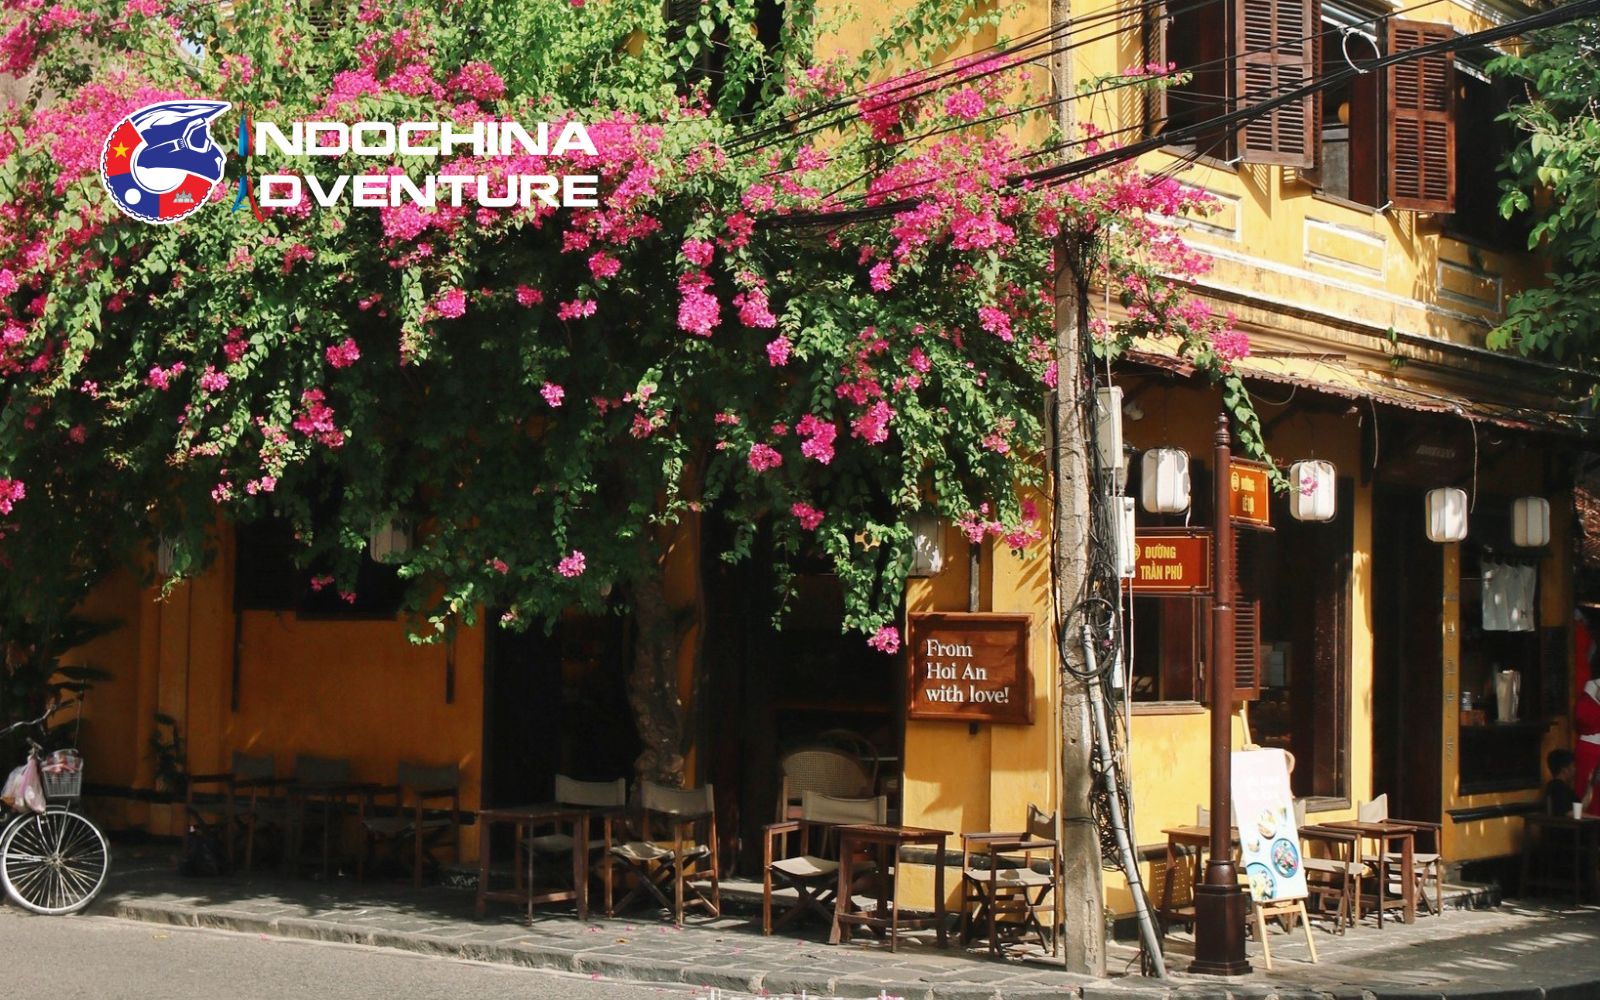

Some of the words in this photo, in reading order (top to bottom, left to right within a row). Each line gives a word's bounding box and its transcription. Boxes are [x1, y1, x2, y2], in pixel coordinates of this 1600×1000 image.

[1144, 543, 1177, 559] ĐƯỜNG
[1140, 560, 1163, 580] TRẦN
[1164, 562, 1183, 580] PHÚ
[926, 639, 973, 657] From
[926, 662, 957, 680] Hoi
[962, 663, 987, 680] An
[926, 685, 964, 703] with
[969, 685, 1010, 704] love!
